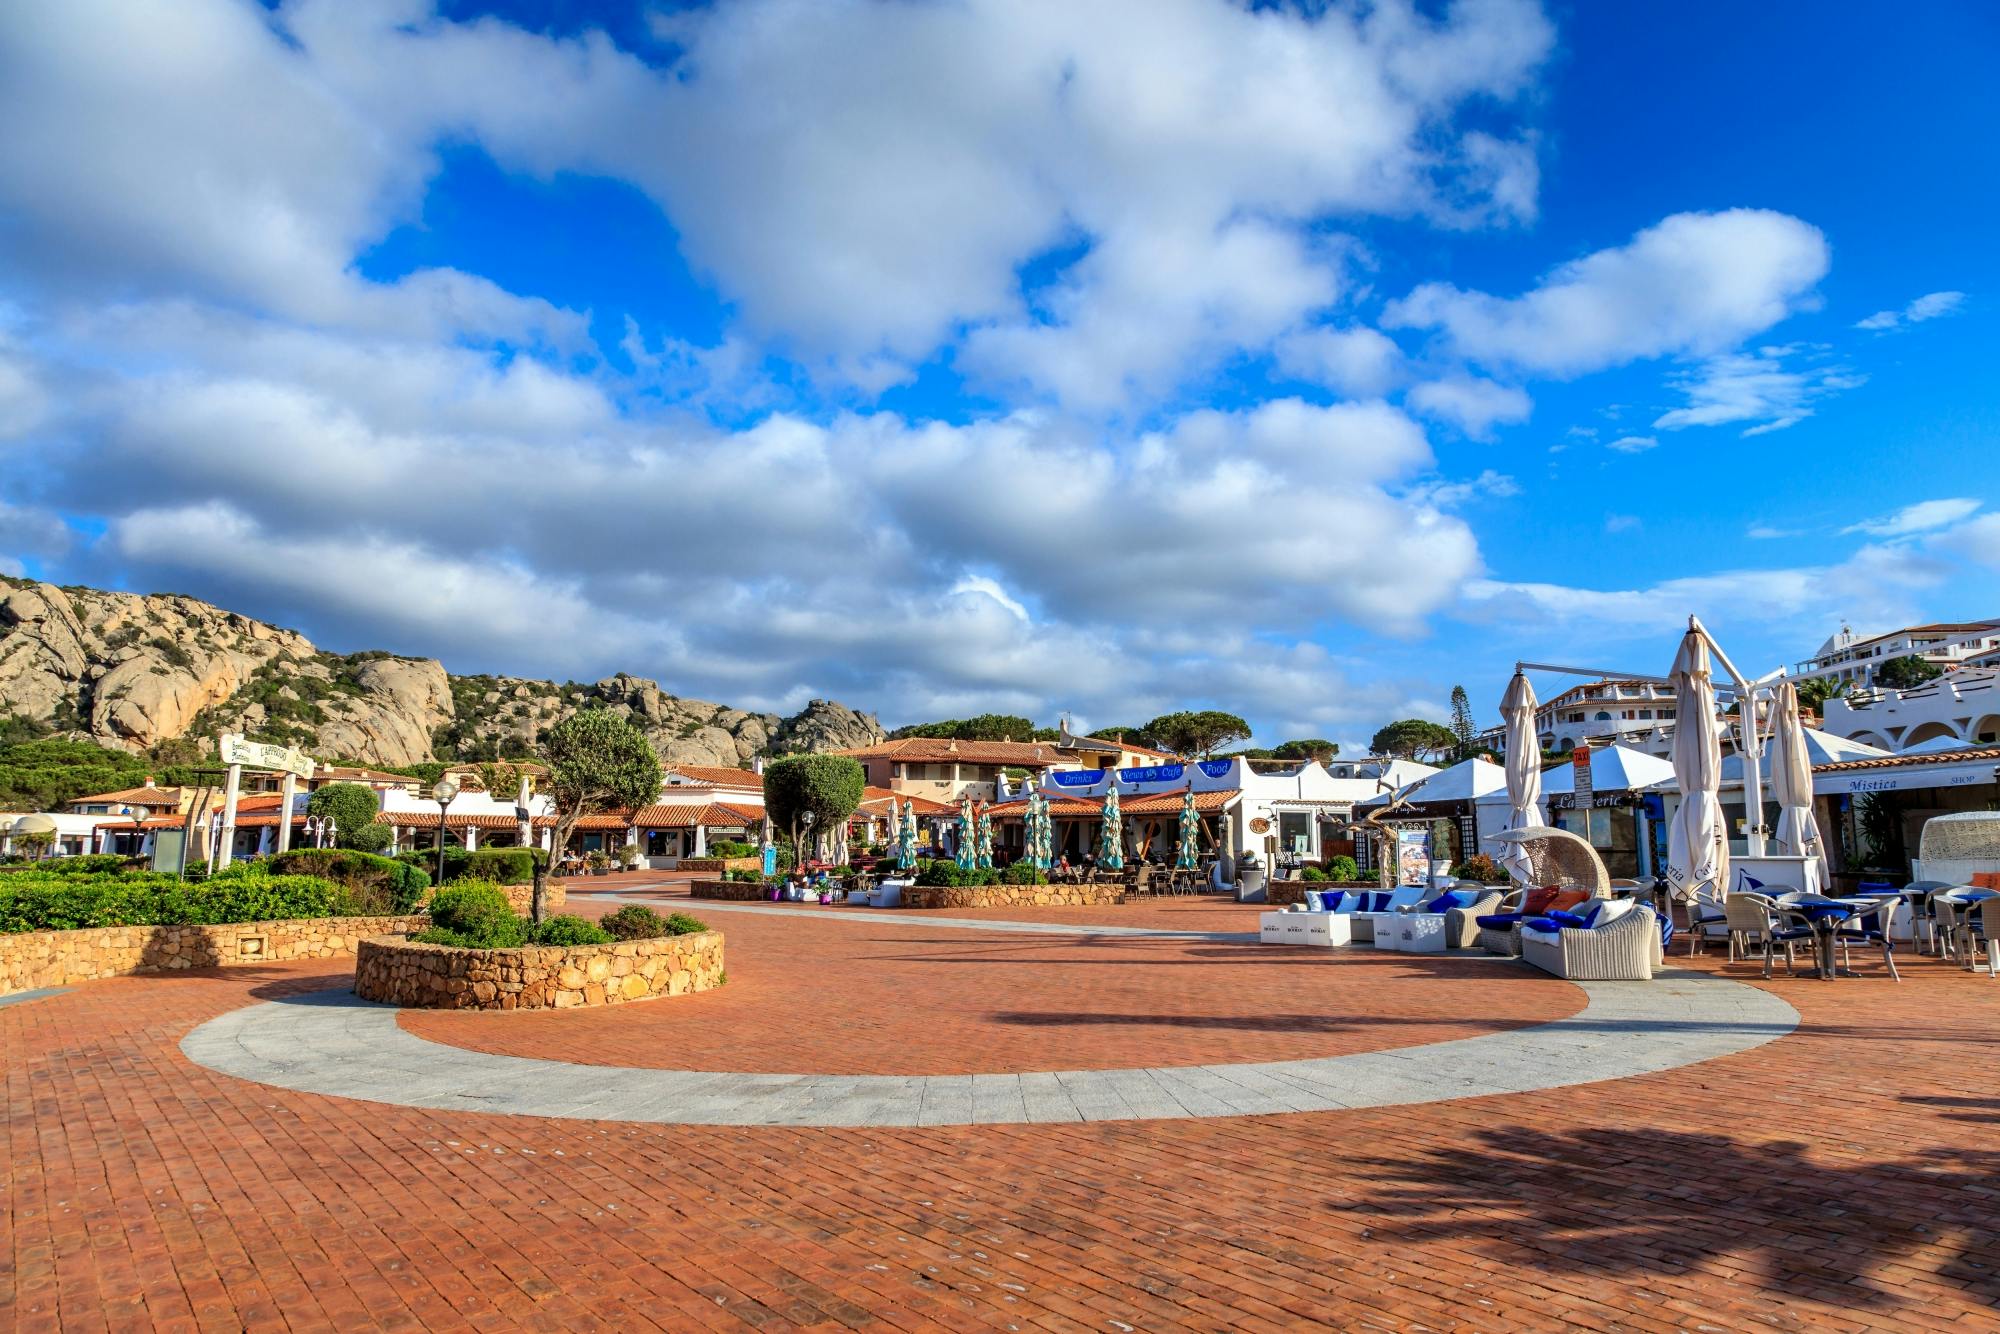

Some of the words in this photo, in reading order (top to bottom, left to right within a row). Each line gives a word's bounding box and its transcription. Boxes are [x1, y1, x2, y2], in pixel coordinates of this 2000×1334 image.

[1574, 751, 1589, 761] TAXI
[1206, 763, 1228, 775] Food
[1065, 774, 1093, 784] Drinks
[1123, 770, 1143, 780] News
[1849, 779, 1897, 792] Mistica
[1950, 776, 1975, 785] SHOP
